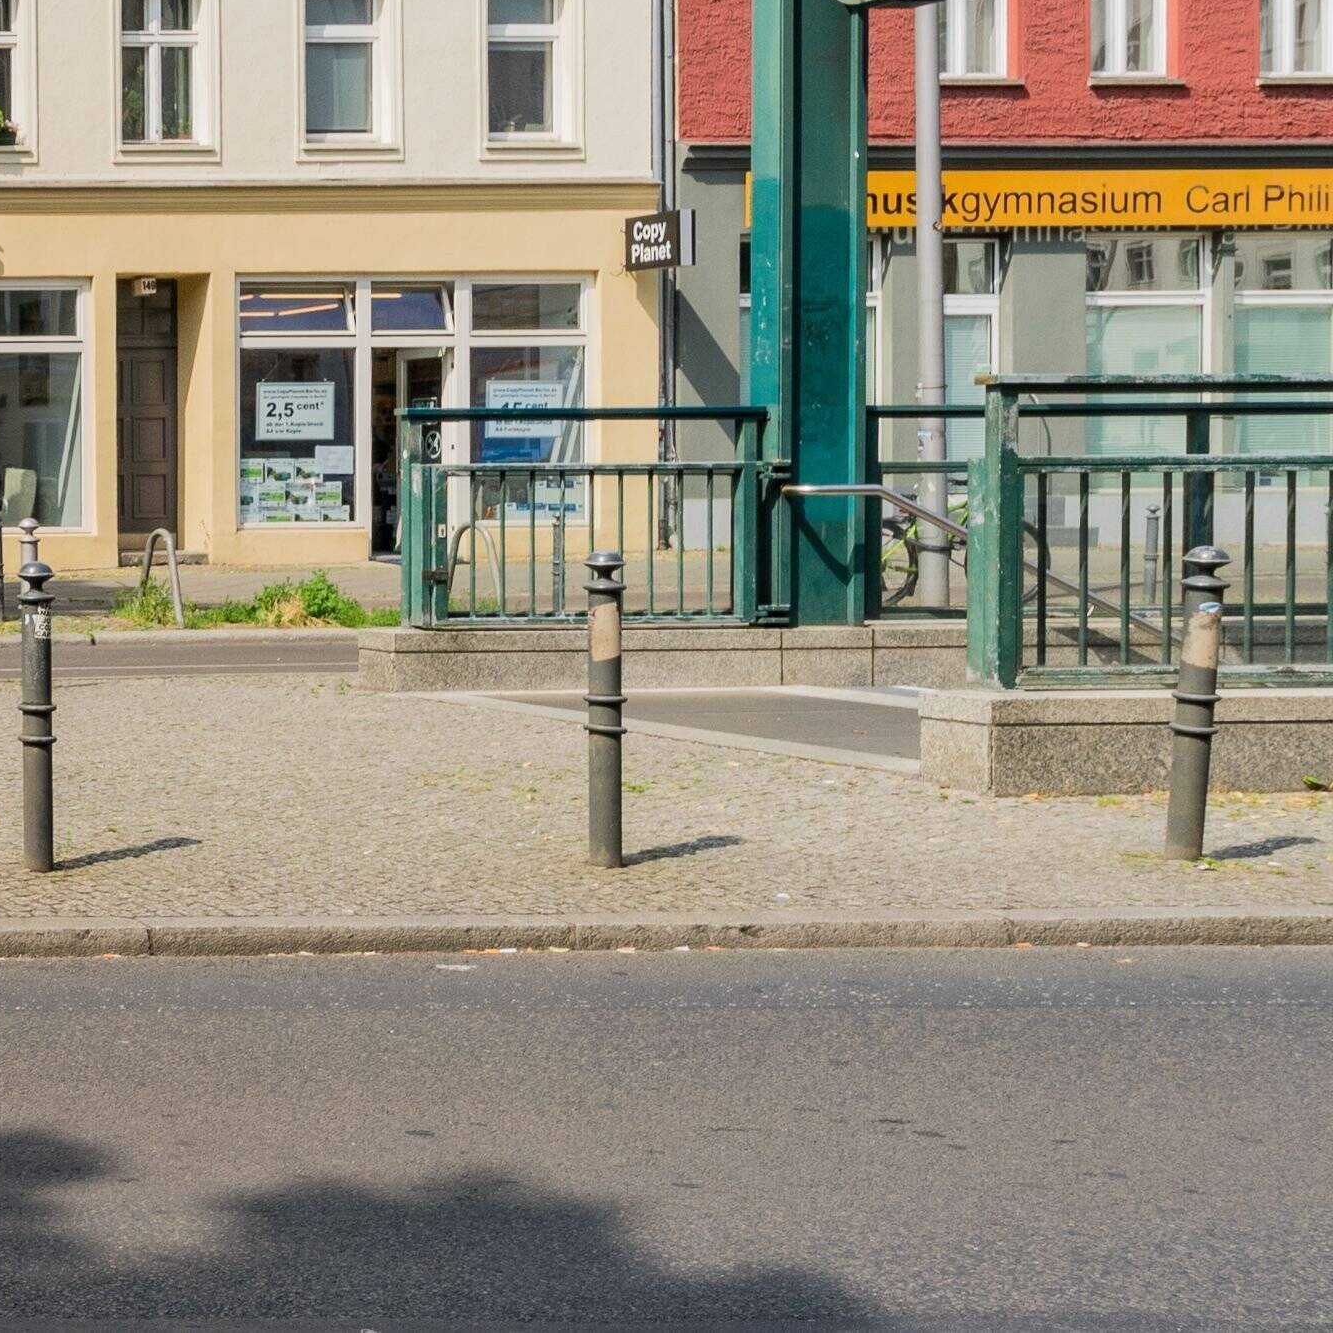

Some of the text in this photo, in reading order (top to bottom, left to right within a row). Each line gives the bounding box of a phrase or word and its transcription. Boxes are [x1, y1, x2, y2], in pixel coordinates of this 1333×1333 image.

[1186, 184, 1250, 214] Carl
[633, 221, 667, 244] Copy
[631, 240, 672, 264] Planet
[266, 402, 294, 420] 2,5
